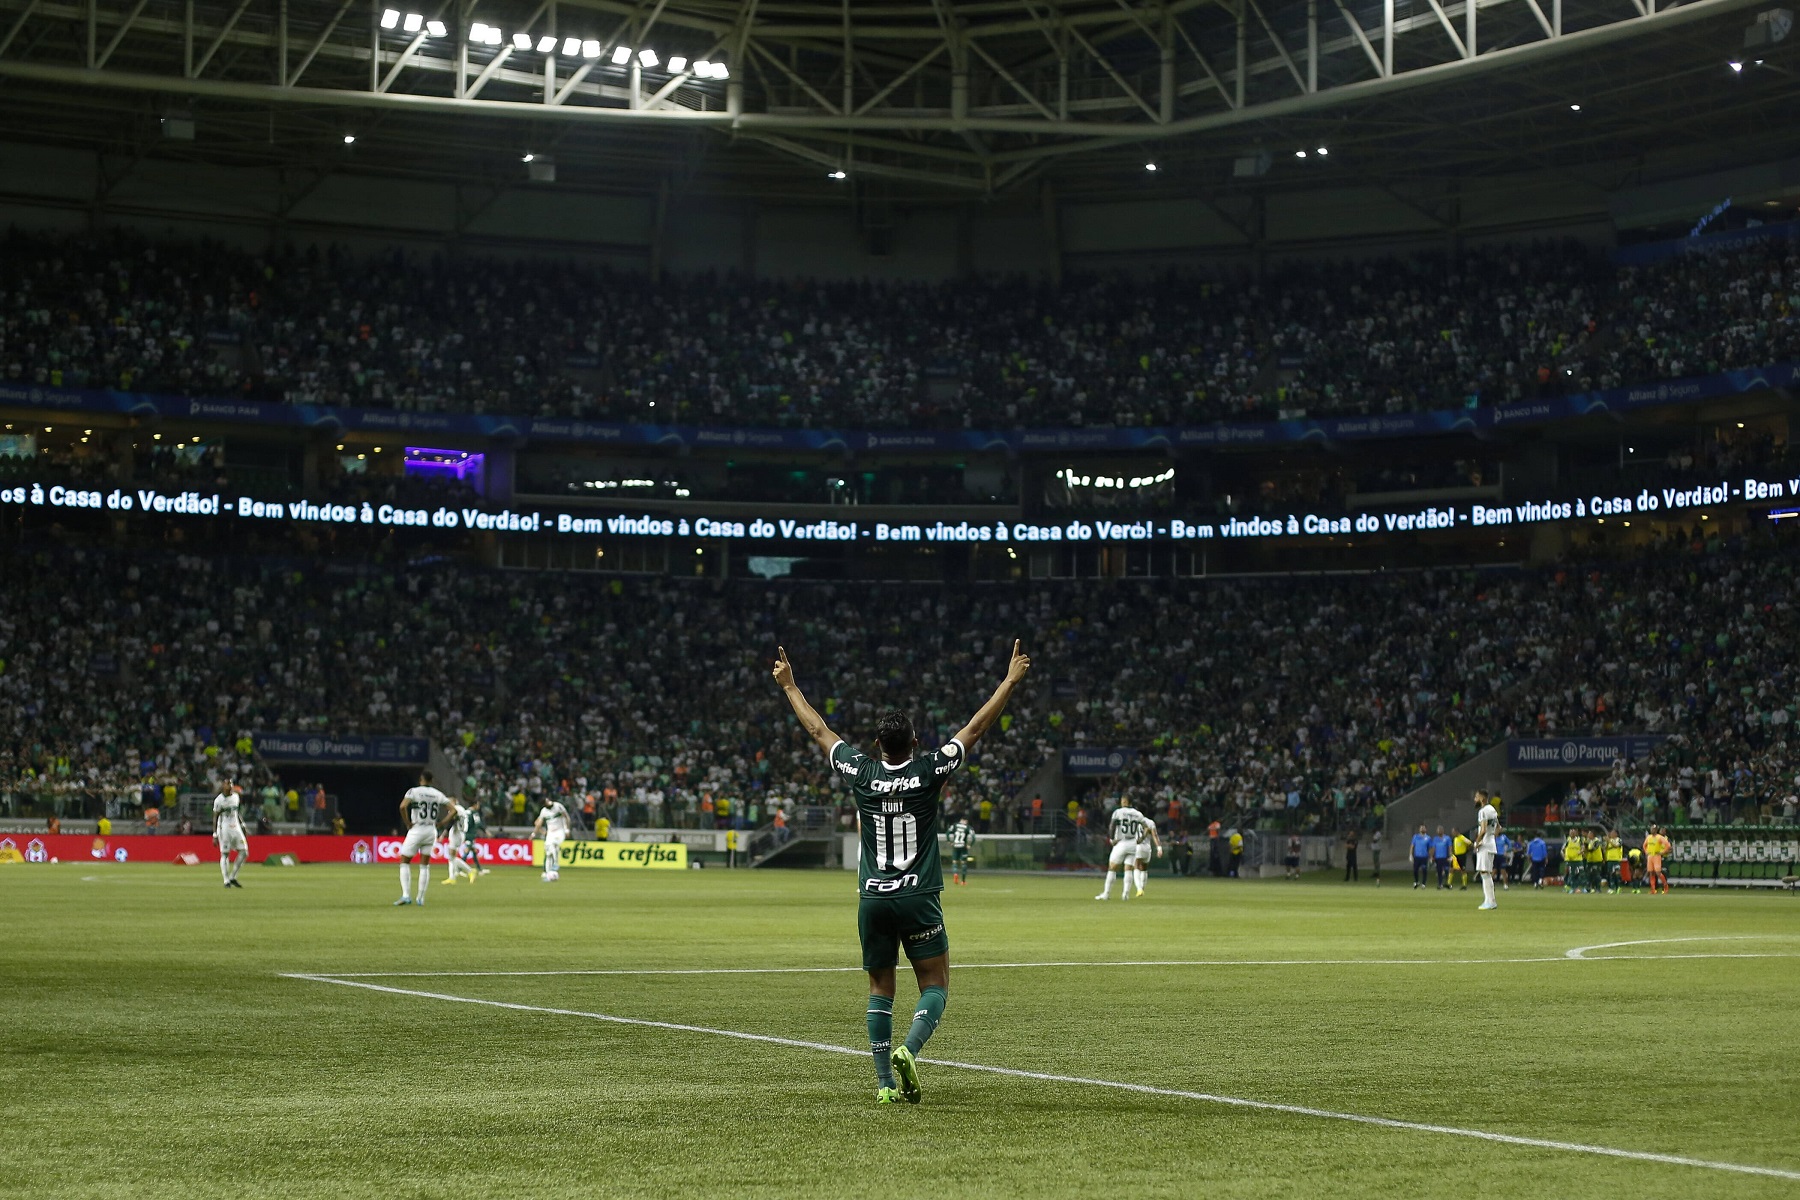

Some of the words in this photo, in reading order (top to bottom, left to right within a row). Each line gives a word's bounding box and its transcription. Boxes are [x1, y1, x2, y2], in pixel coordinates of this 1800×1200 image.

[1629, 390, 1657, 401] Allianz
[1669, 384, 1700, 398] Seguros
[30, 482, 45, 505] à
[49, 485, 102, 509] Casa
[106, 488, 133, 510] do
[137, 489, 219, 515] Verdão!
[238, 496, 284, 519] Bem
[288, 498, 357, 523] vindos
[360, 501, 374, 524] à
[377, 504, 428, 527] Casa
[432, 506, 459, 528] do
[461, 508, 540, 532] Verdão!
[557, 513, 603, 534] Bem
[607, 514, 674, 536] vindos
[677, 516, 690, 537] à
[694, 517, 745, 538] Casa
[749, 518, 776, 538] do
[779, 519, 857, 540] Verdão!
[875, 523, 921, 541] Bem
[925, 521, 992, 541] vindos
[995, 521, 1009, 541] à
[1013, 523, 1062, 541] Casa
[1065, 520, 1092, 540] do
[1171, 519, 1214, 539] Bem
[1220, 515, 1283, 537] vindos
[1286, 514, 1300, 535] à
[1303, 514, 1351, 534] Casa
[1355, 513, 1380, 533] do
[1384, 506, 1455, 531] Verdão!
[1472, 505, 1513, 526] Bem
[1516, 499, 1572, 522] vindos
[1575, 497, 1586, 518] à
[1590, 496, 1632, 516] Casa
[1636, 488, 1659, 512] do
[1662, 481, 1728, 509] Verdão!
[1744, 478, 1783, 501] Bem
[258, 738, 303, 753] Allianz
[323, 740, 366, 757] Parque
[1518, 745, 1560, 761] Allianz
[1579, 744, 1619, 761] Parque
[1069, 755, 1107, 766] Allianz
[870, 776, 921, 796] crefisa
[418, 800, 439, 820] 36
[1121, 818, 1138, 835] 50
[872, 812, 918, 871] 10
[498, 842, 533, 862] GOL
[618, 844, 678, 866] crefisa
